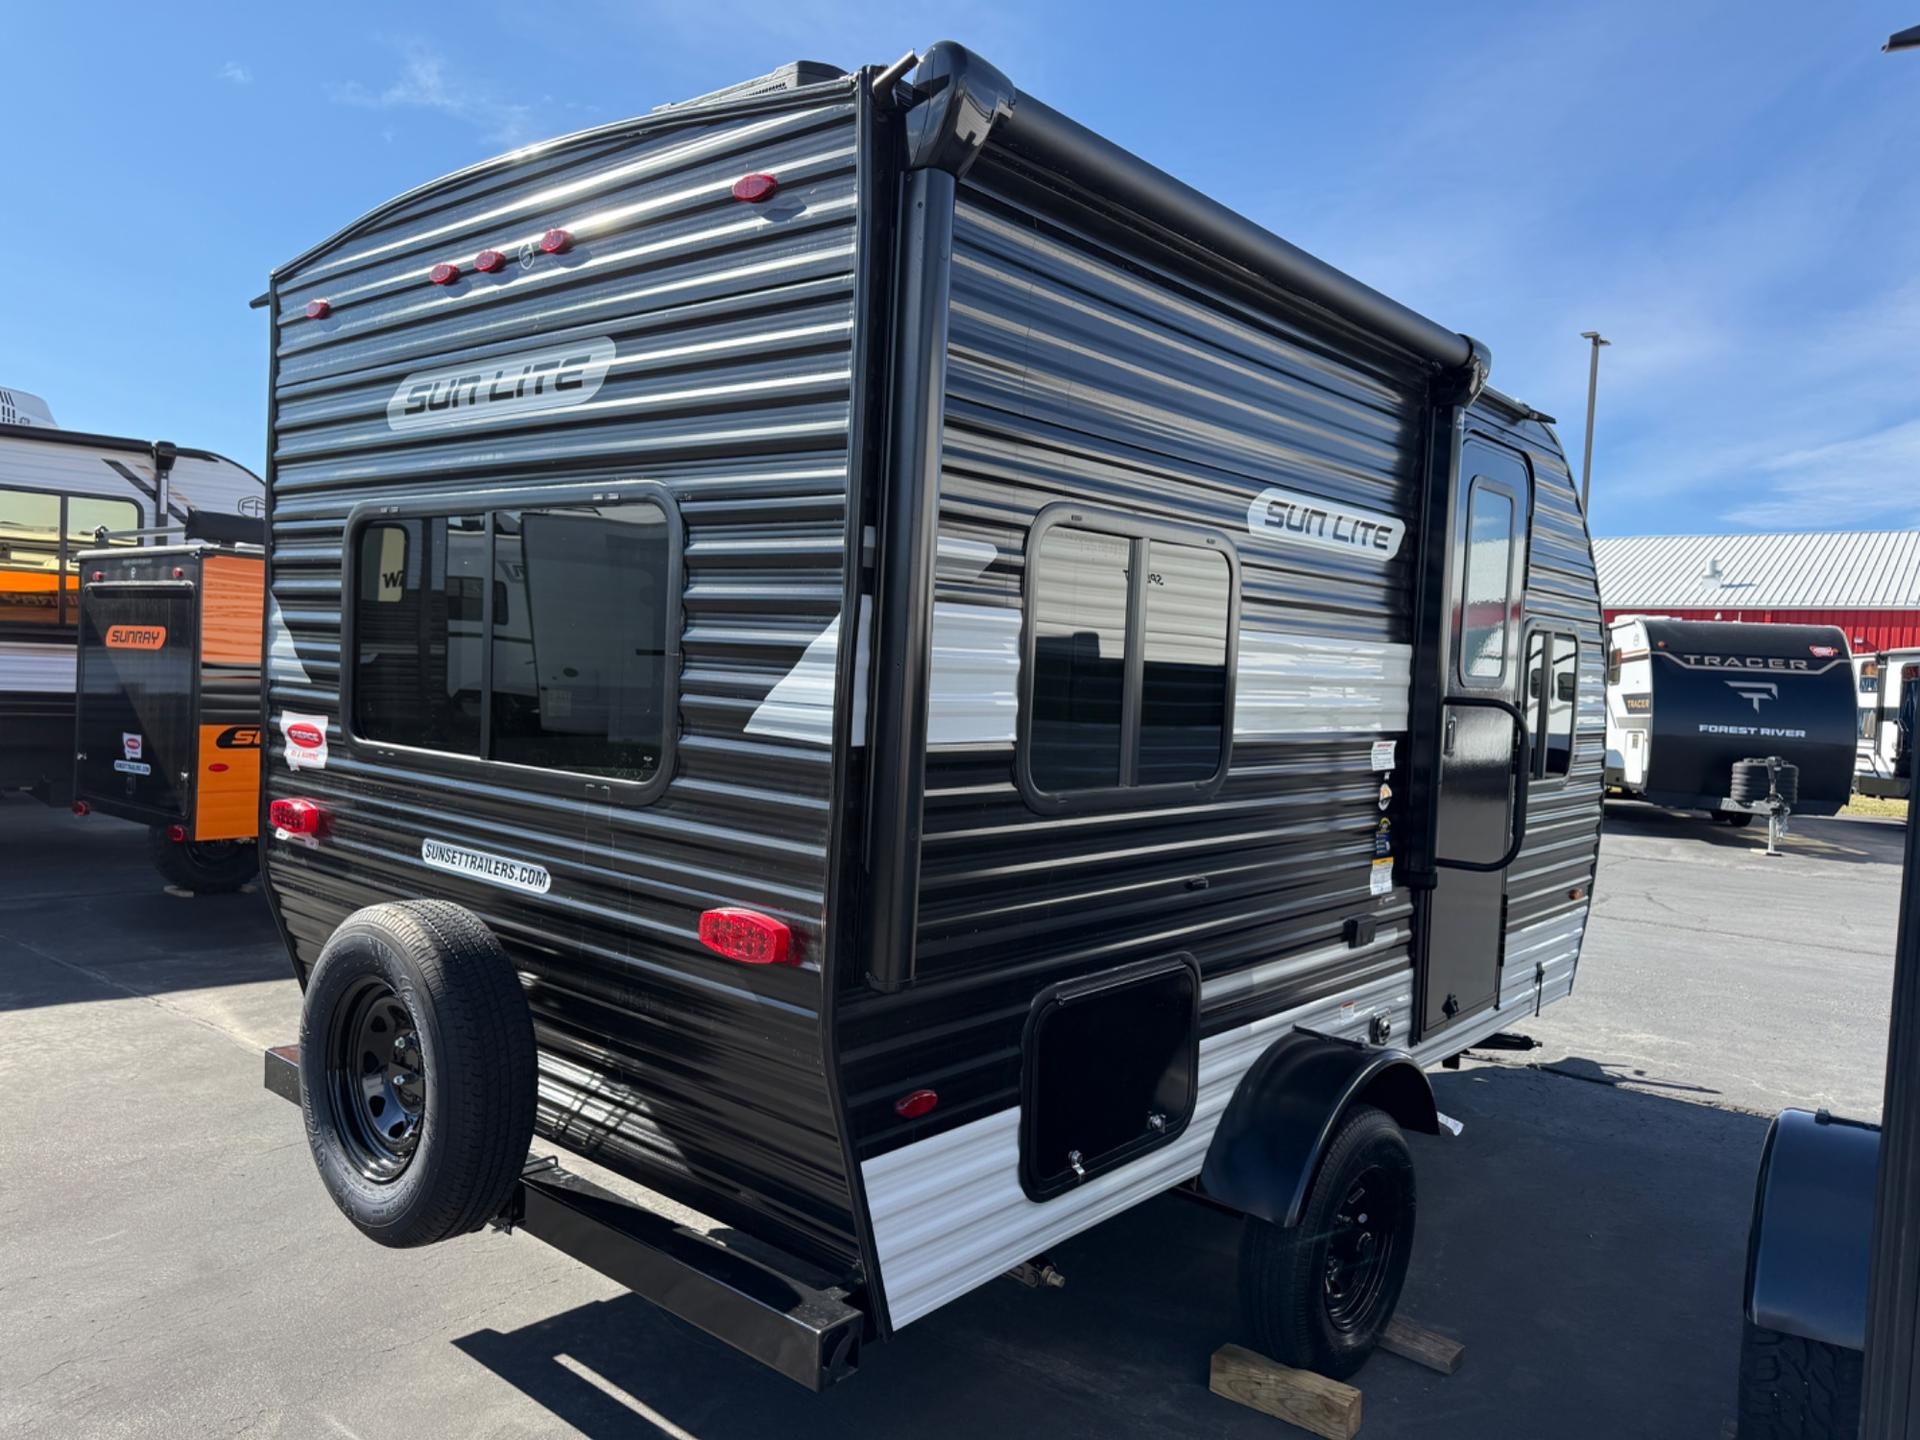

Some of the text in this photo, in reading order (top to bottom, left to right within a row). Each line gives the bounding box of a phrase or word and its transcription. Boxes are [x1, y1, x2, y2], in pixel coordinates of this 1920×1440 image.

[405, 354, 591, 416] SUN LITE
[1265, 500, 1393, 551] SUN LITE
[111, 630, 160, 645] SUNRAY
[1684, 654, 1808, 670] TRACER
[1627, 699, 1649, 709] TRACER
[1699, 724, 1806, 738] FOREST RIVER
[425, 843, 548, 888] SUNSETTRAILERS.COM
